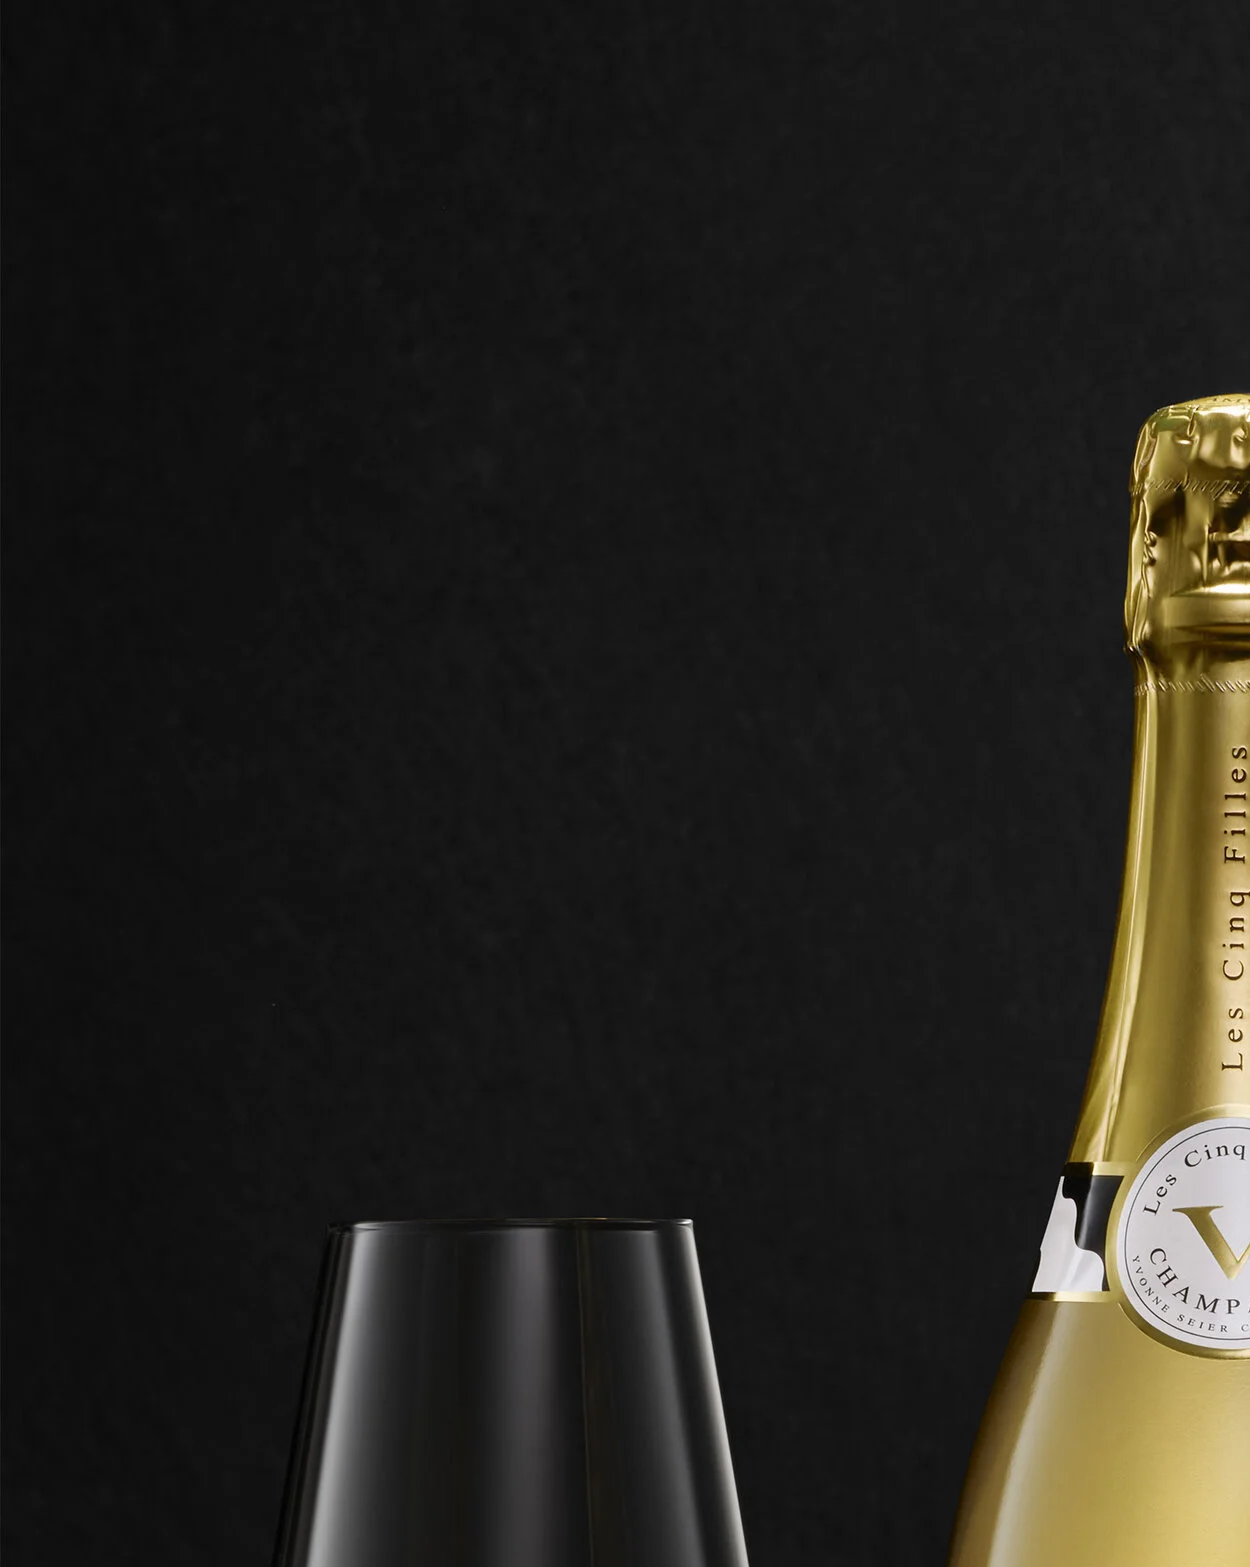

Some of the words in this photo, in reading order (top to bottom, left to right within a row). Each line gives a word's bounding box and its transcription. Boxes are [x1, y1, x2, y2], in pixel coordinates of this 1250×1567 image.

[1224, 745, 1248, 864] Filles
[1221, 1006, 1244, 1071] Les
[1143, 1173, 1177, 1217] Les
[1184, 1144, 1247, 1168] Cinq
[1132, 1255, 1170, 1314] YVONNE
[1176, 1313, 1229, 1333] SEIER
